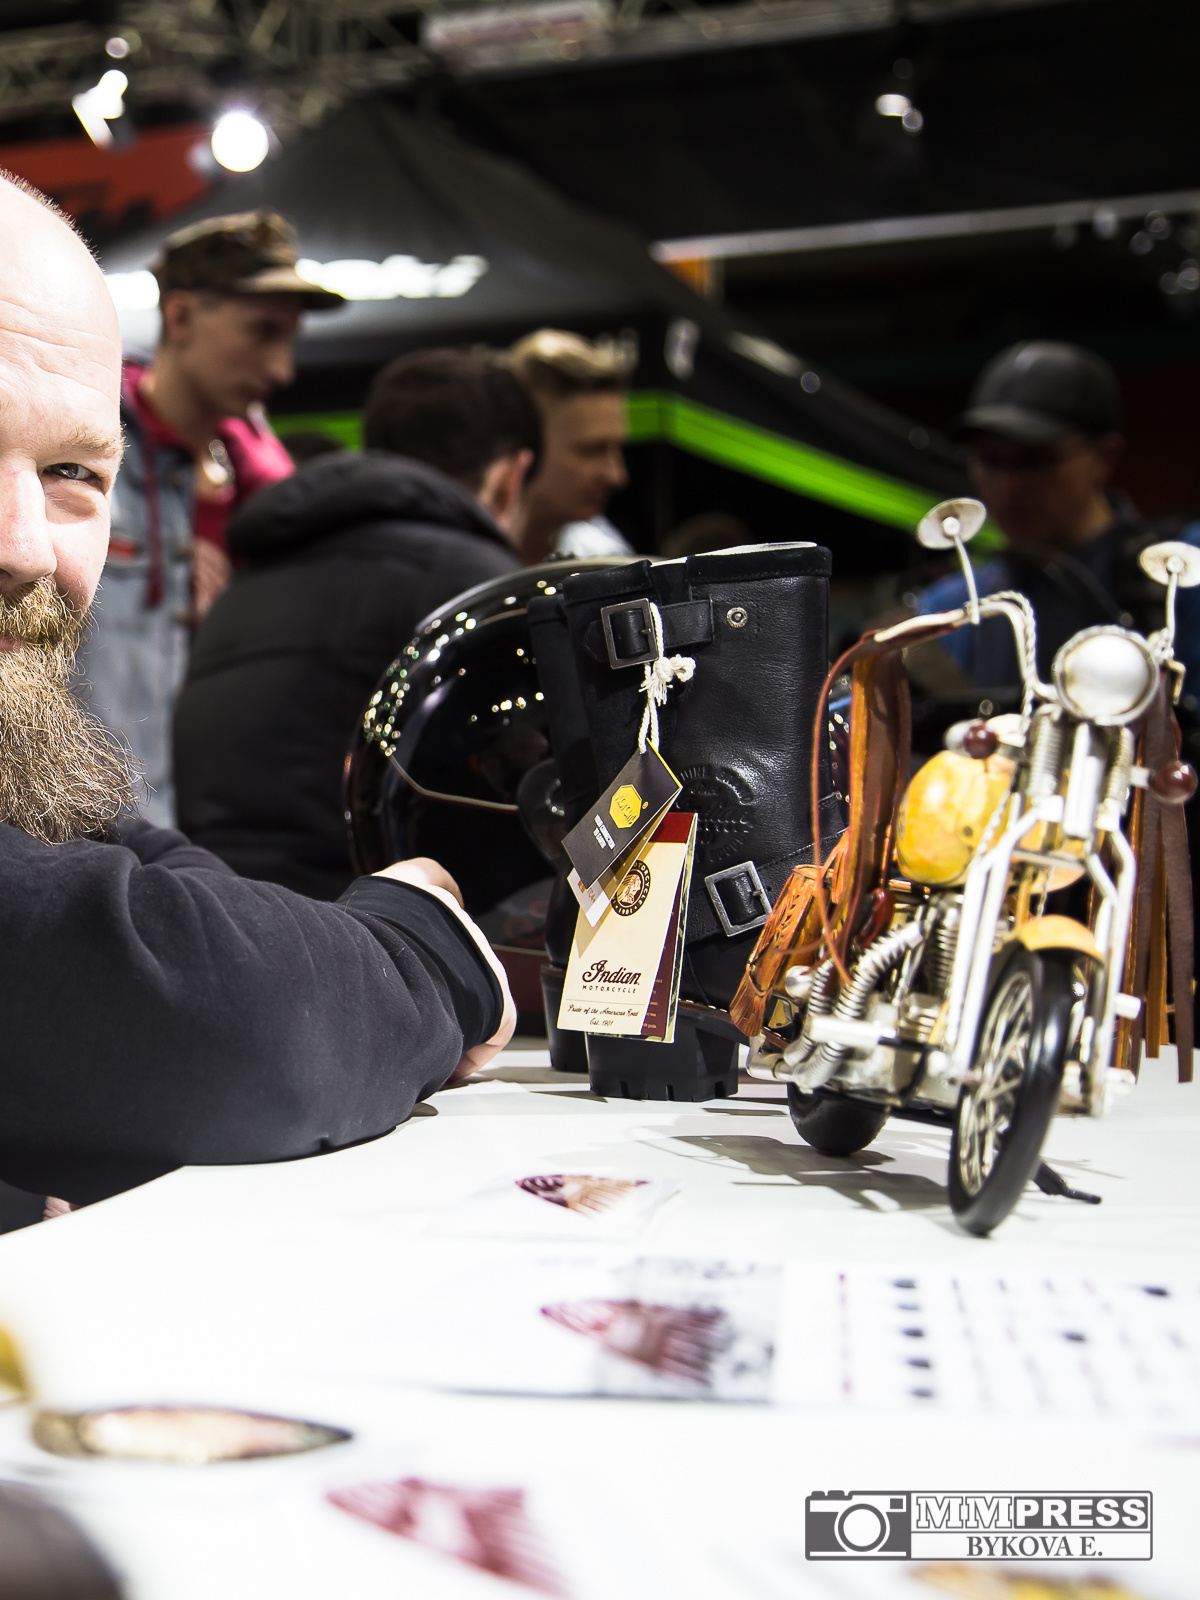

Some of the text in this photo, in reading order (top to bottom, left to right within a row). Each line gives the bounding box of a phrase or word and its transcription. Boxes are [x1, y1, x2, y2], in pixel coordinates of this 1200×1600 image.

[582, 959, 642, 985] Indian
[582, 985, 636, 994] MOTORCYCLE
[567, 1004, 582, 1013] Pride
[583, 1007, 591, 1015] of
[599, 1007, 626, 1016] American
